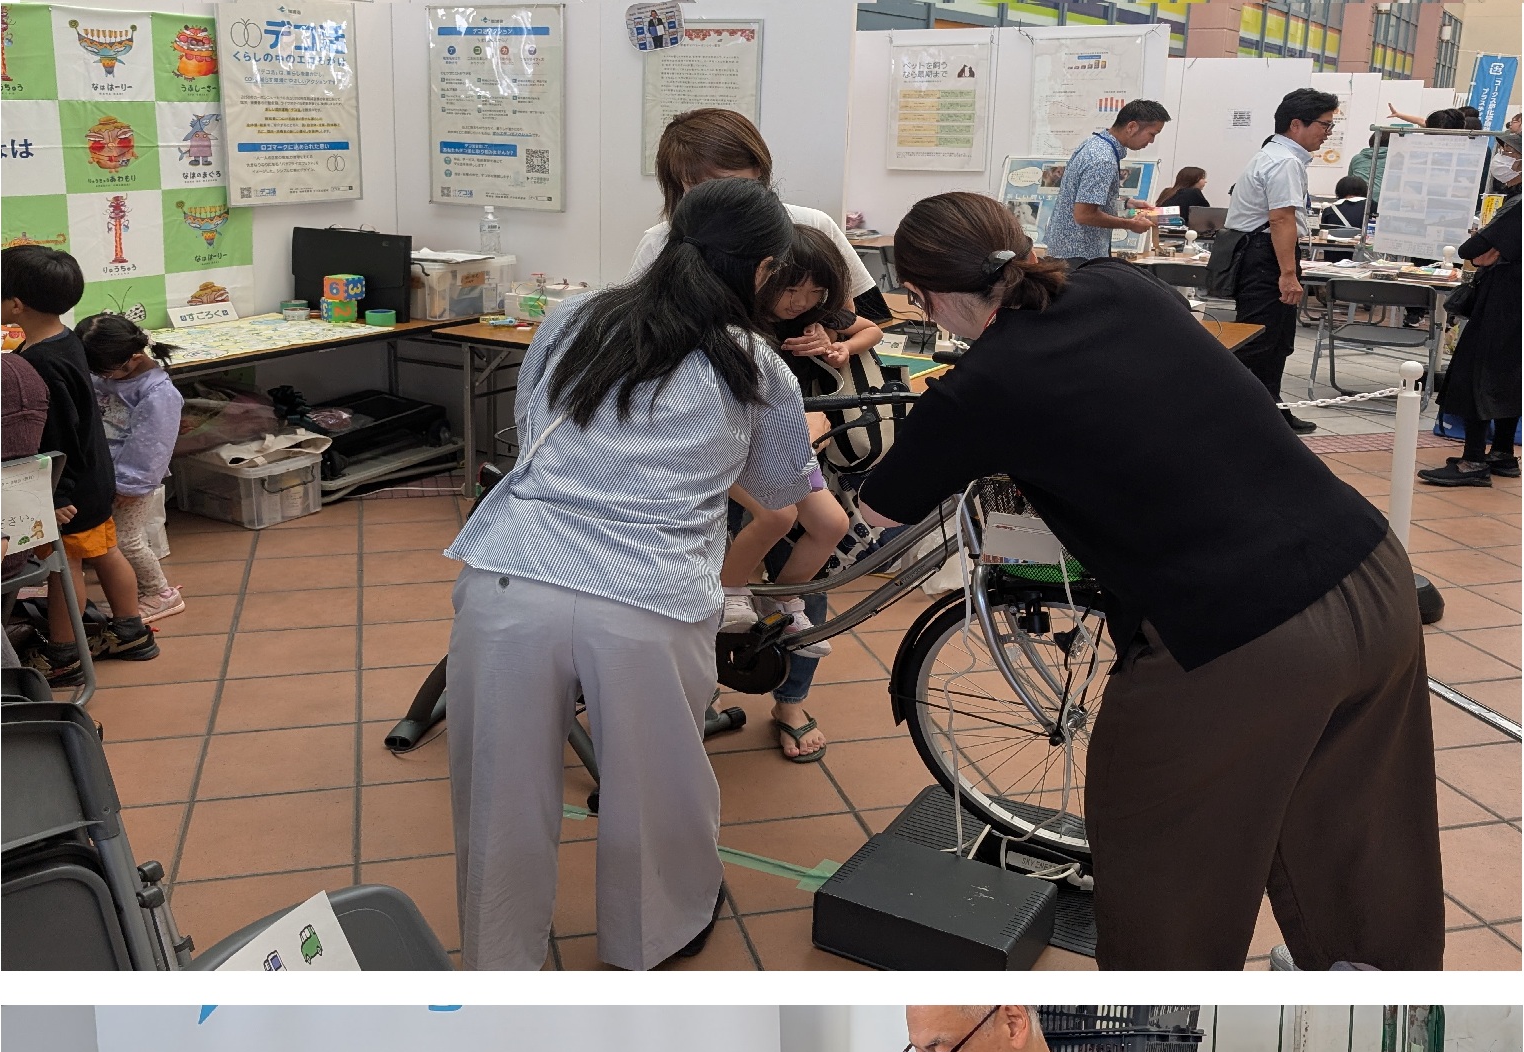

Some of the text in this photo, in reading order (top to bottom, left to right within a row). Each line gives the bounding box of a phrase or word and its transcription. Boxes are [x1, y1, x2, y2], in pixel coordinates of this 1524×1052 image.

[902, 61, 948, 70] ペットを飼う
[180, 84, 218, 93] うふしーさー
[182, 170, 222, 180] なはのまぐろ
[102, 263, 138, 274] りゅうちゅう
[329, 282, 341, 295] 6
[348, 283, 362, 295] 3
[334, 306, 352, 317] 2
